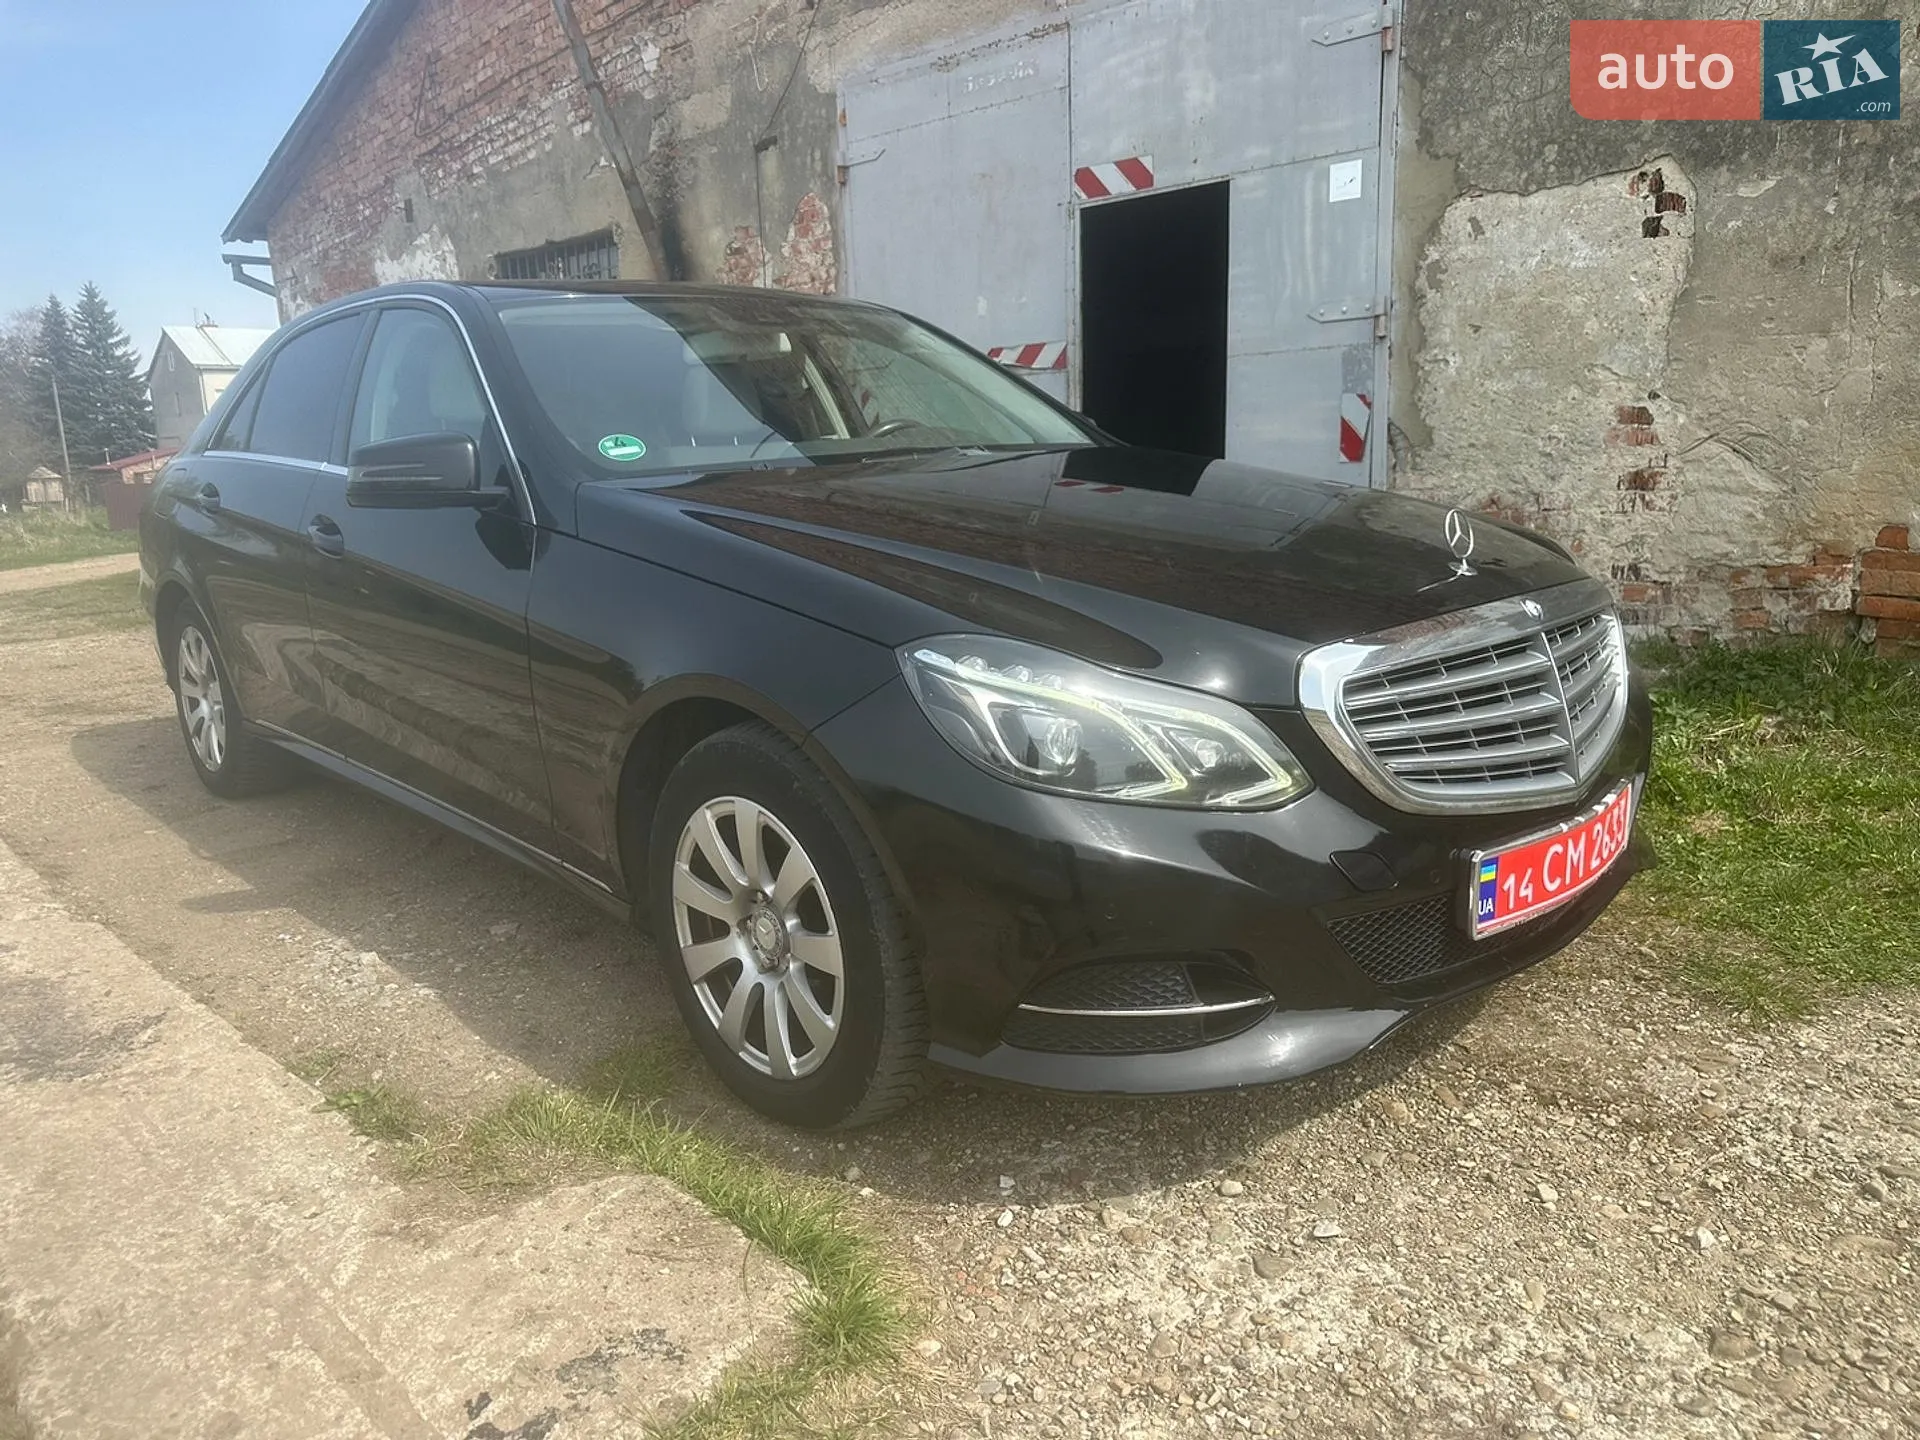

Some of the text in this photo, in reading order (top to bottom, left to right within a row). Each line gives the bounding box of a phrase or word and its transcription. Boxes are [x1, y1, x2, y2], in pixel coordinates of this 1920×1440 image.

[1503, 868, 1533, 909] 14
[1543, 832, 1586, 892] CM
[1478, 898, 1494, 915] UA
